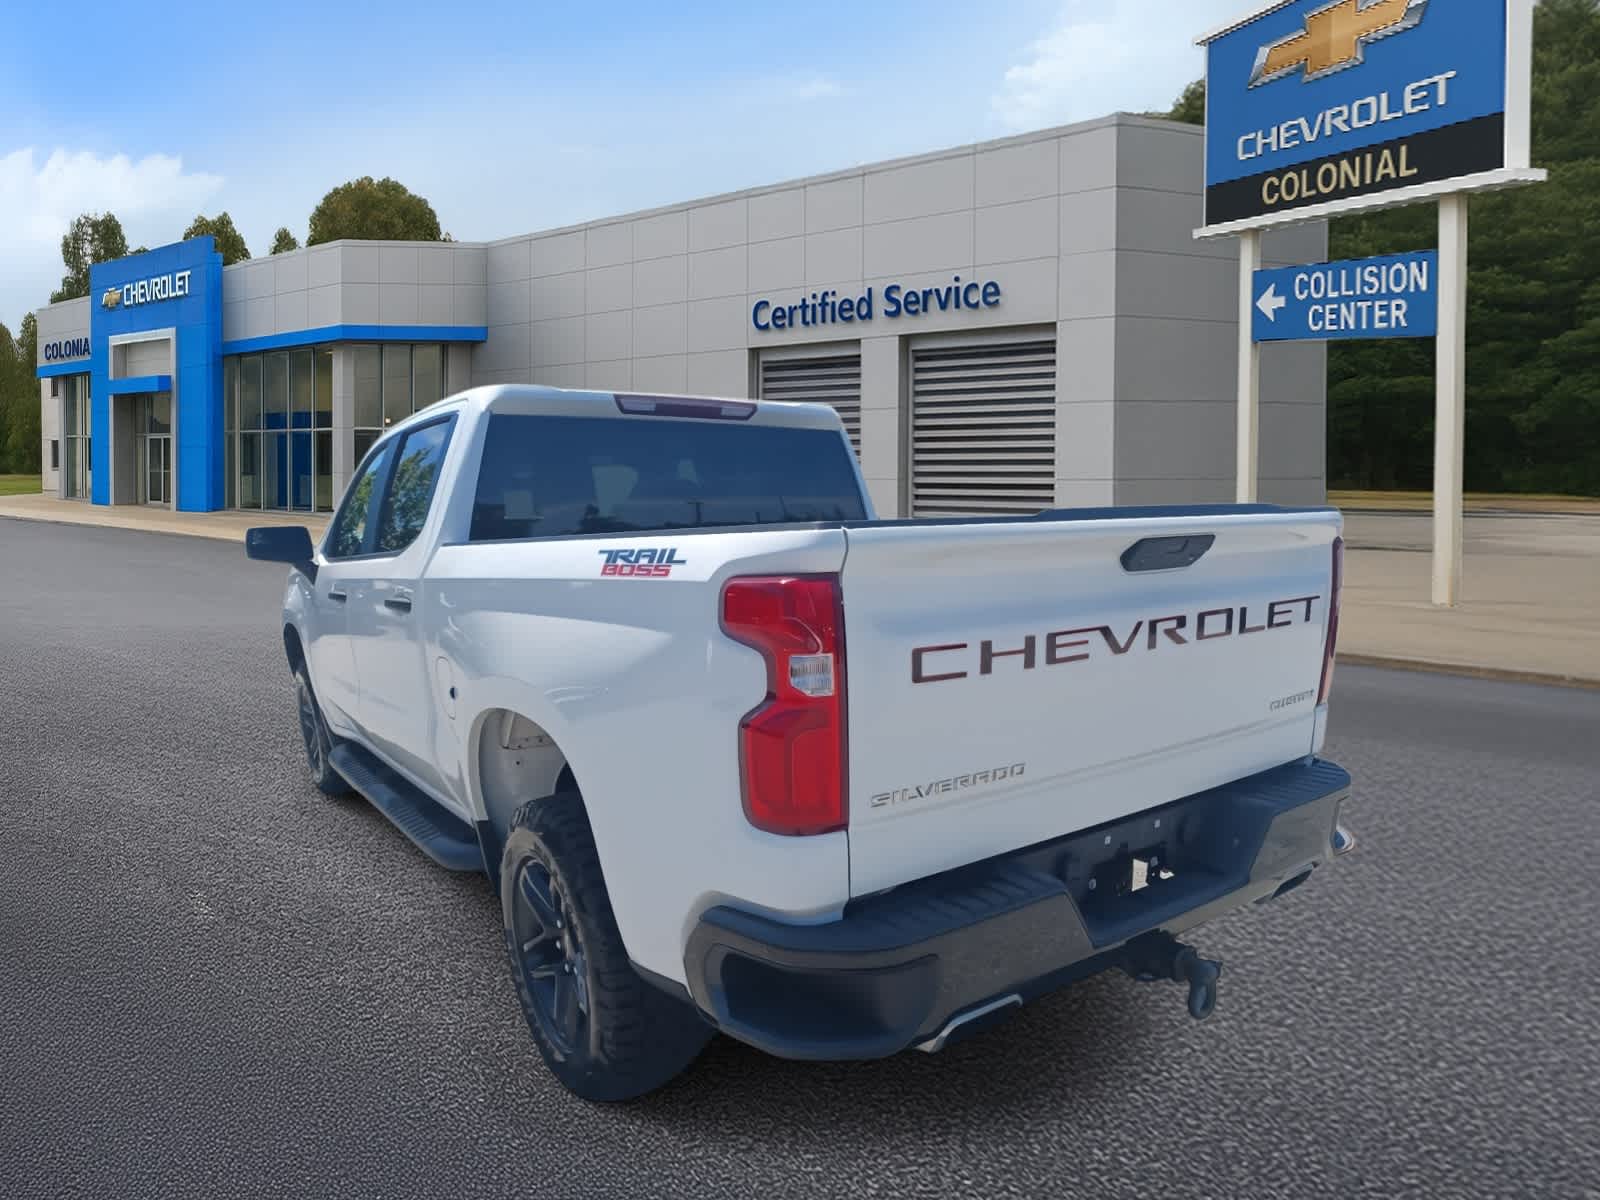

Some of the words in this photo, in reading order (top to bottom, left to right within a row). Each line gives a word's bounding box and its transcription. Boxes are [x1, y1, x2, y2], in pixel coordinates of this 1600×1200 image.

[1236, 70, 1457, 161] CHEVROLET
[1261, 144, 1418, 205] COLONIAL
[122, 270, 191, 307] CHEVROLET
[1293, 260, 1429, 300] COLLISION
[752, 287, 873, 331] Certified
[883, 275, 1001, 318] Service
[1307, 298, 1409, 332] CENTER
[598, 548, 687, 565] TRAIL
[600, 564, 672, 577] BOSS
[911, 595, 1321, 684] CHEVROLET
[870, 762, 1026, 809] SILVERADO
